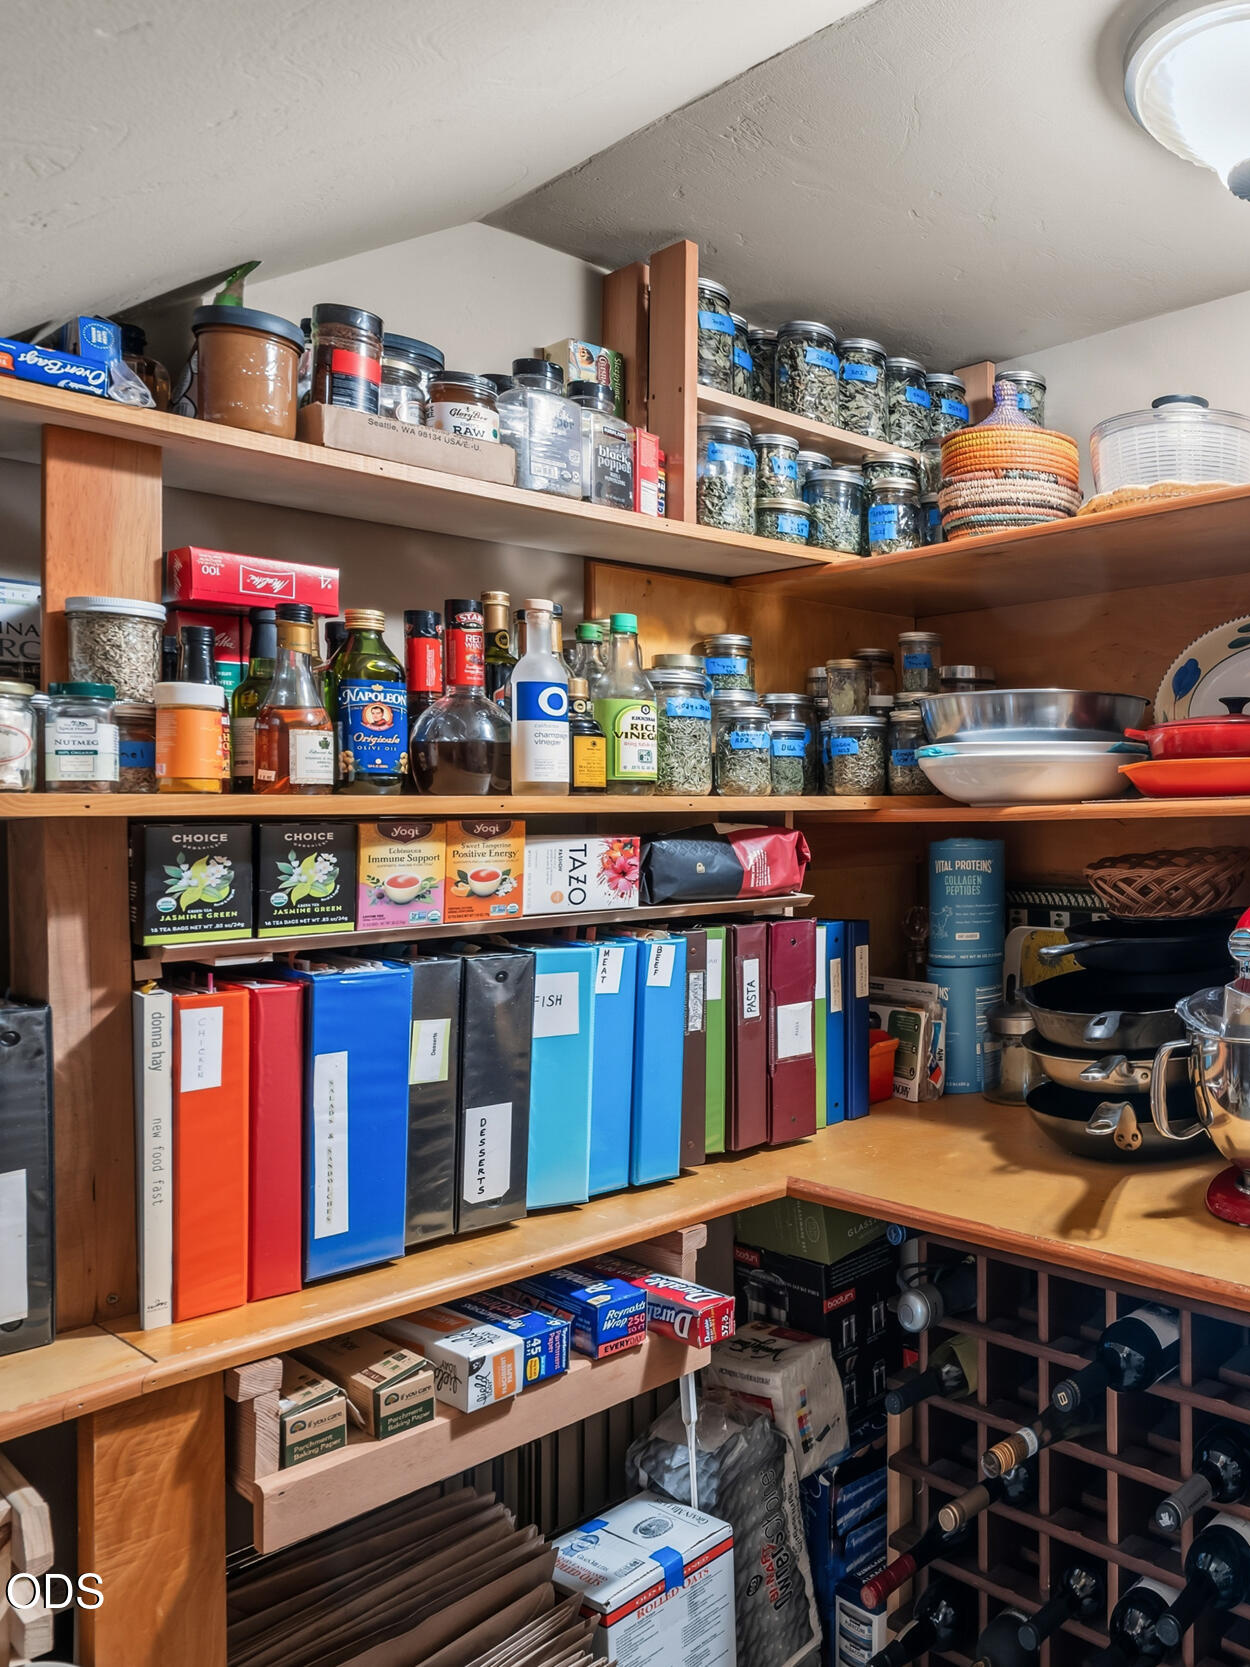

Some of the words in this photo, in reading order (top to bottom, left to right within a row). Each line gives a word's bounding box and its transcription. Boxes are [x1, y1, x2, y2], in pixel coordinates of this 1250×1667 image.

[614, 356, 622, 401] Sleepytime
[367, 417, 399, 433] Seattle,
[401, 426, 416, 436] WA
[418, 428, 442, 442] 98134
[452, 425, 486, 439] RAW
[598, 445, 629, 462] black
[201, 564, 221, 577] 100
[247, 573, 290, 594] Melitta
[342, 687, 407, 705] NAPOLEON
[54, 738, 99, 746] NUTMEG
[171, 833, 229, 843] CHOICE
[284, 832, 334, 841] CHOICE
[368, 854, 405, 864] Immune
[407, 853, 440, 864] Support
[452, 849, 487, 858] Positive
[489, 849, 517, 859] Energy
[568, 843, 588, 906] TAZO
[935, 860, 952, 874] VITAL
[954, 859, 993, 874] PROTEINS
[944, 875, 983, 886] COLLAGEN
[945, 885, 981, 896] PEPTIDES
[160, 914, 203, 922] JASMINE
[206, 911, 238, 919] GREEN
[314, 905, 343, 913] GREEN
[601, 949, 610, 984] MEAT
[653, 945, 663, 976] BEEF
[534, 993, 563, 1008] FISH
[746, 979, 757, 1014] PASTA
[150, 1011, 163, 1043] donna
[430, 1031, 439, 1056] Desserts
[148, 1050, 165, 1073] hay
[152, 1117, 163, 1139] new
[152, 1145, 164, 1173] food
[477, 1116, 487, 1195] DESSERTS
[152, 1179, 164, 1207] fast
[646, 1275, 716, 1303] Durable
[827, 1290, 855, 1309] bodum
[605, 1299, 646, 1320] Reynolds
[602, 1315, 628, 1331] Wrap
[627, 1312, 646, 1327] 250
[531, 1337, 541, 1356] 45
[406, 1388, 418, 1401] you
[417, 1384, 432, 1396] care
[312, 1416, 327, 1429] you
[327, 1410, 343, 1423] care
[387, 1406, 424, 1424] Parchment
[387, 1417, 412, 1432] Baking
[411, 1409, 431, 1425] Paper
[293, 1433, 333, 1453] Parchment
[293, 1446, 319, 1461] Baking
[319, 1437, 342, 1453] Paper
[636, 1586, 680, 1619] ROLLED
[682, 1568, 710, 1590] OATS
